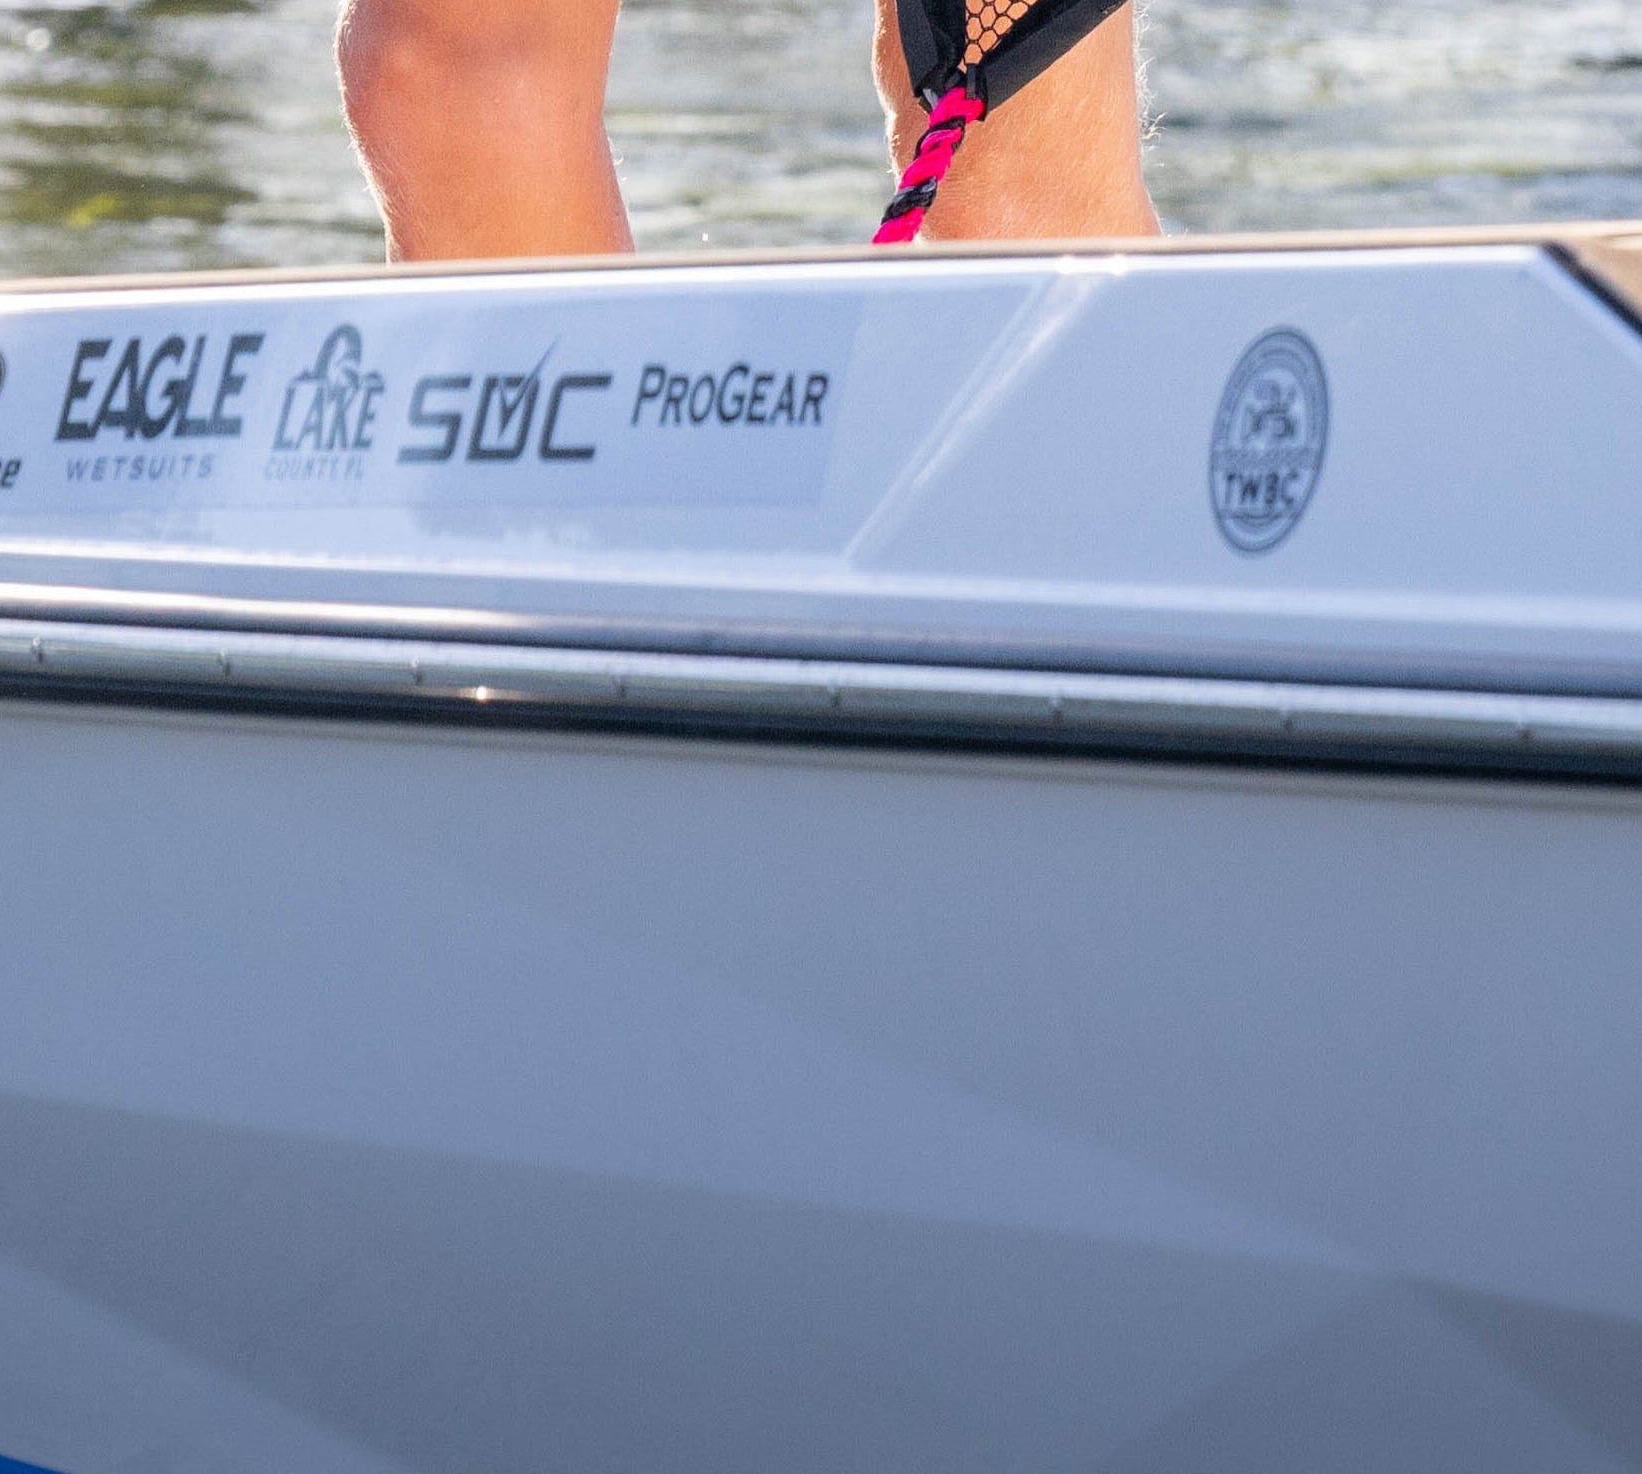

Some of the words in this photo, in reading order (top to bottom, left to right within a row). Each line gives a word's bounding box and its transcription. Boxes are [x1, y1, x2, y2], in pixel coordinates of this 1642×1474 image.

[55, 331, 267, 441] EAGLE
[271, 384, 385, 449] LAKE
[67, 455, 214, 481] WETSUITS
